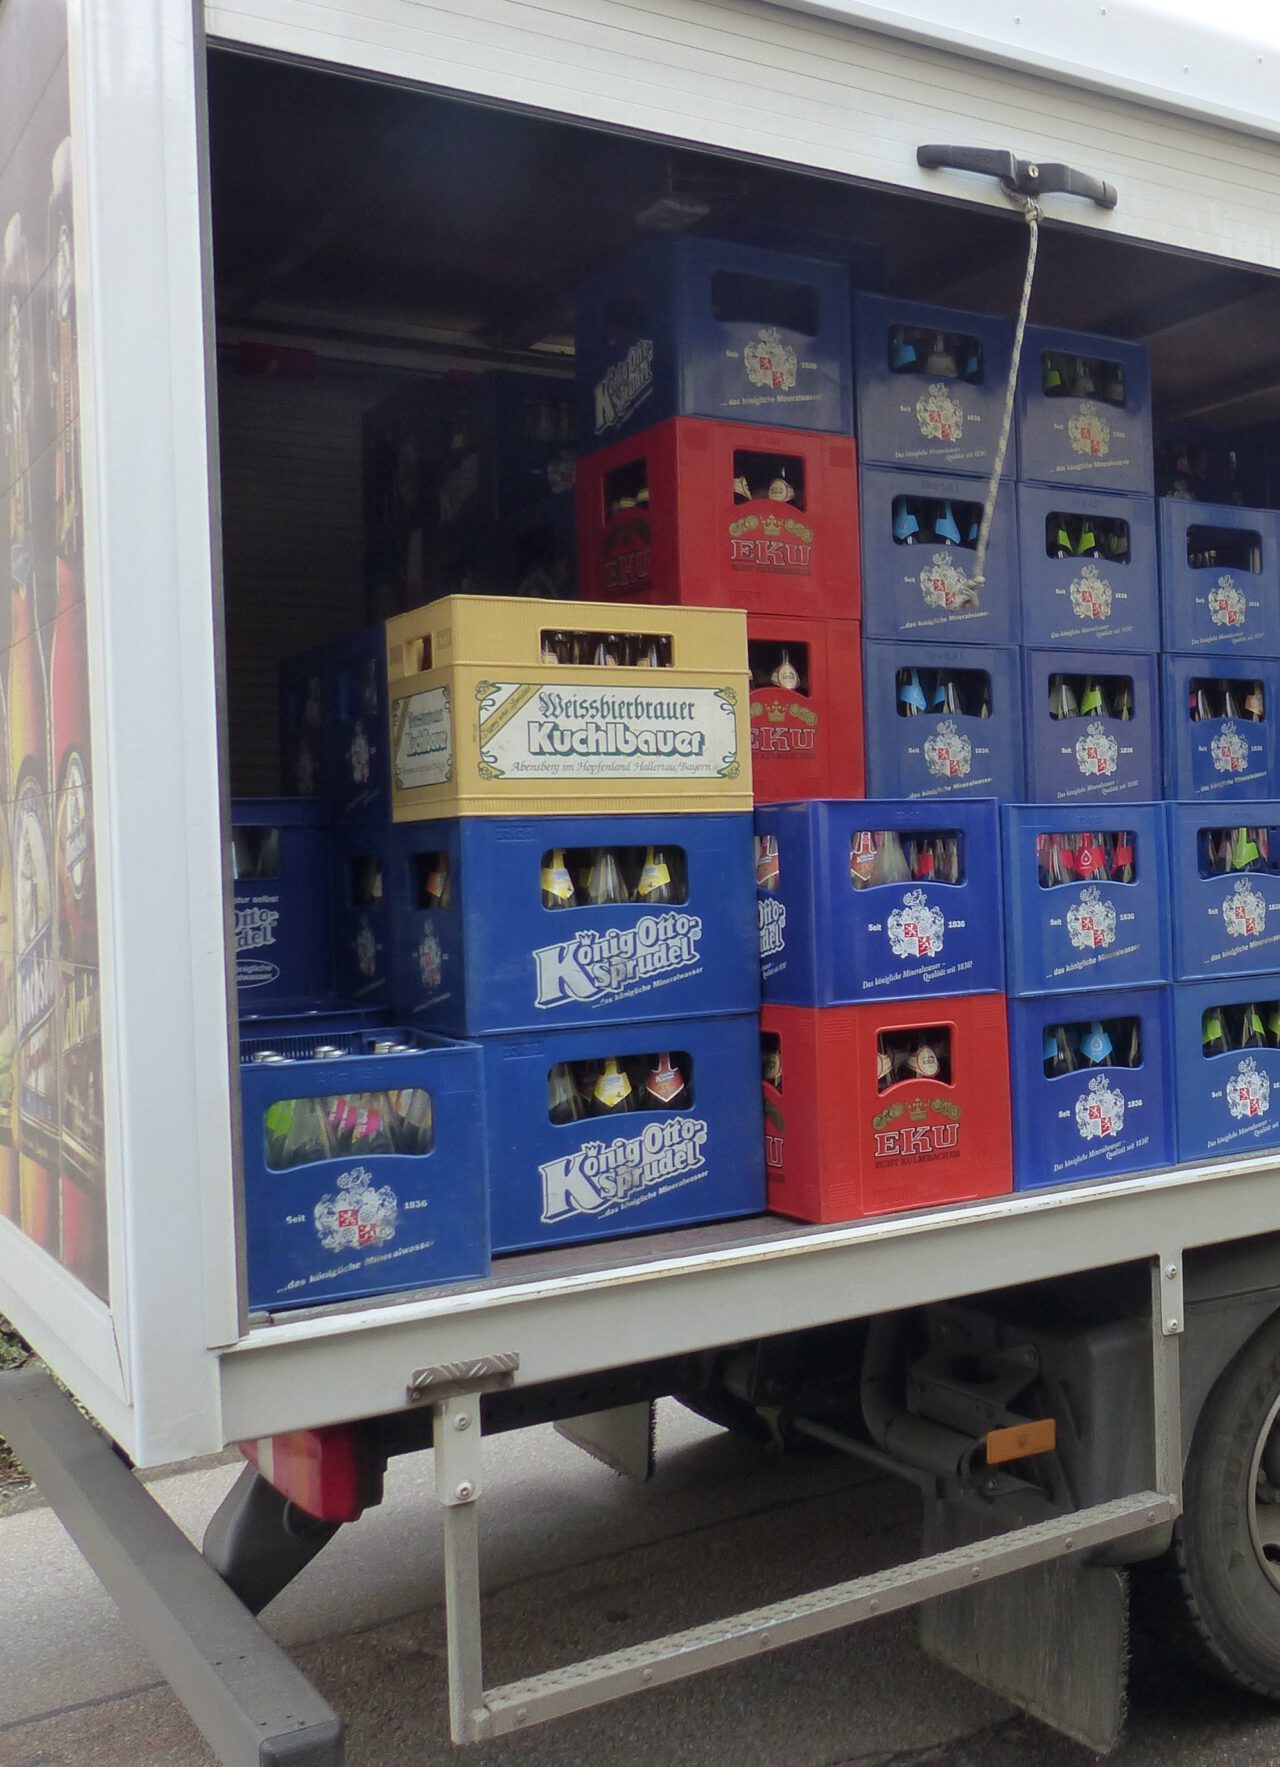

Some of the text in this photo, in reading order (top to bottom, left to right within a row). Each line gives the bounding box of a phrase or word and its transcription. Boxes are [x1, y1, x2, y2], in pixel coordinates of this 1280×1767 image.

[731, 539, 811, 566] EKU
[539, 692, 695, 720] Weissbierbrauer
[528, 721, 705, 757] Kuchlbauer
[511, 762, 561, 774] Abensberg
[562, 763, 574, 772] im
[575, 761, 630, 775] Hopfenland
[533, 930, 636, 1008] König
[637, 912, 702, 947] Otto-
[592, 936, 700, 991] Sprudel
[615, 984, 651, 1002] königliche
[653, 967, 704, 988] Mineralwasser
[875, 1123, 959, 1157] EKU
[539, 1117, 707, 1223] König Otto-
[598, 1141, 706, 1202] Sprudel
[621, 1191, 657, 1210] königliche
[659, 1170, 709, 1195] Mineralwasser
[286, 1200, 428, 1224] Seit 1836
[309, 1262, 361, 1284] königliche
